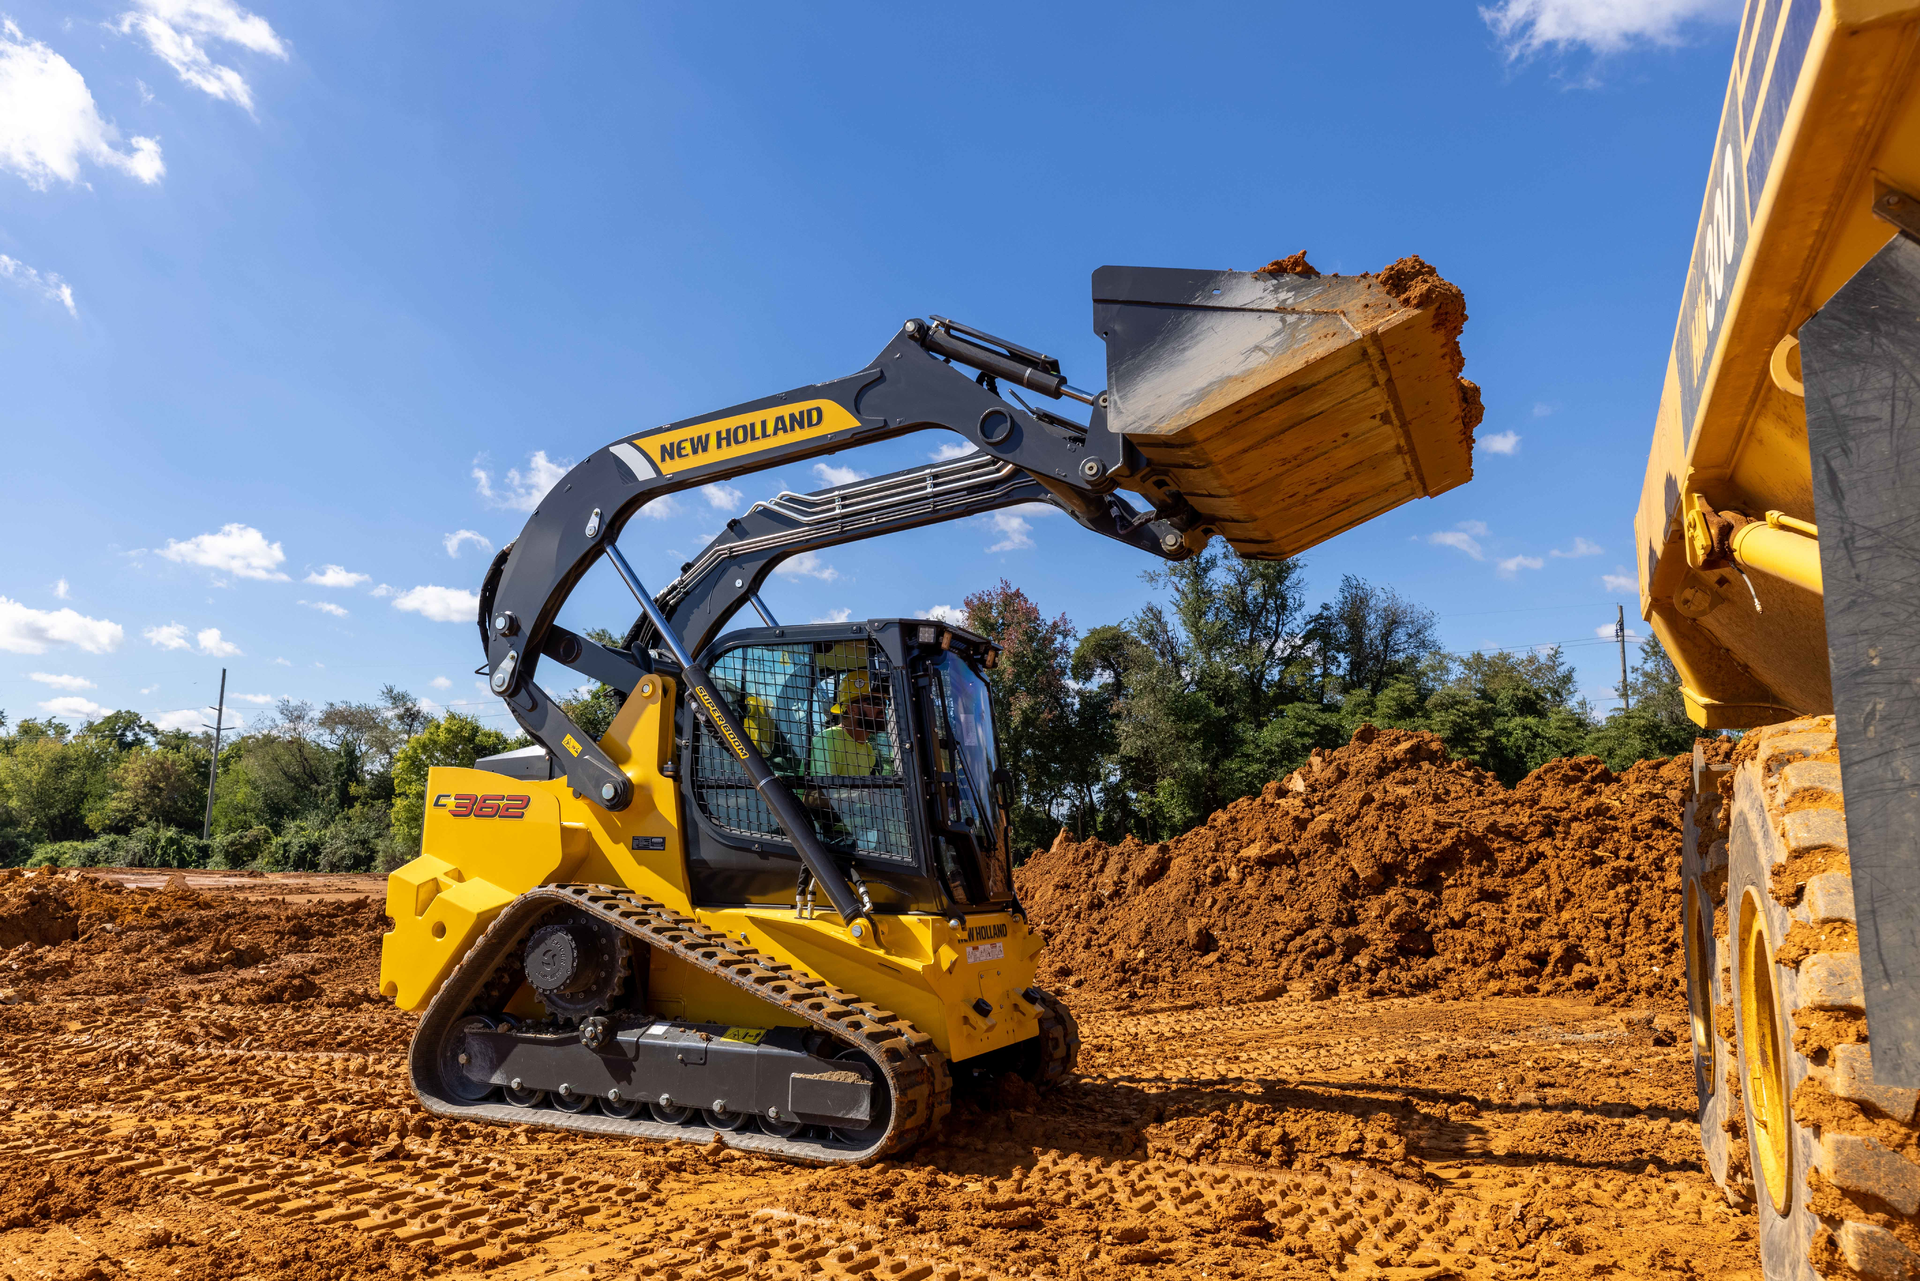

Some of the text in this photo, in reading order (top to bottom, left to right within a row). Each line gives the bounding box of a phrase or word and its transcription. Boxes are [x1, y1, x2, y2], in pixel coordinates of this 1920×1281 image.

[660, 406, 823, 463] NEW HOLLAND
[696, 686, 749, 759] SUPER BOOM
[433, 794, 531, 819] C362
[975, 923, 1007, 941] HOLLAND
